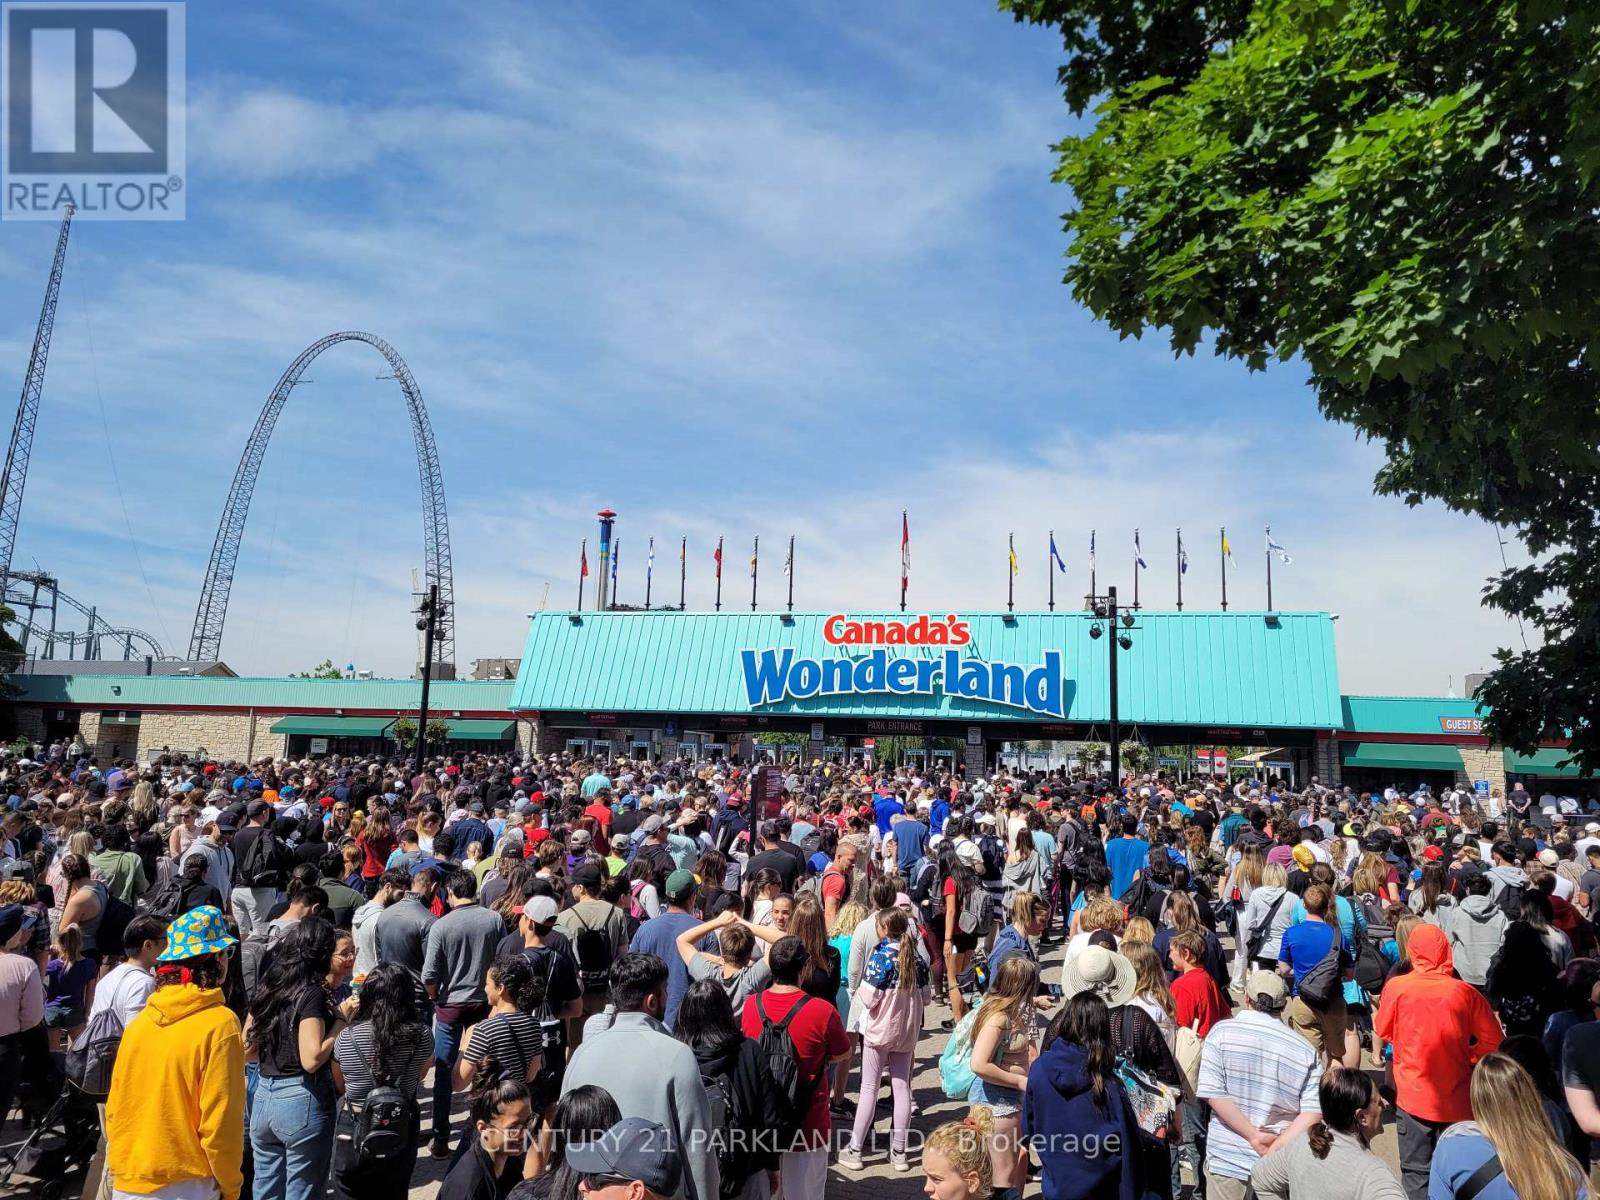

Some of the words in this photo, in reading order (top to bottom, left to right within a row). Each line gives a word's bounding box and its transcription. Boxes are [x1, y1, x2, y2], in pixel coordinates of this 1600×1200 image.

[823, 614, 971, 646] Canada's
[740, 648, 1065, 718] Wonderland
[867, 721, 885, 731] PARK
[888, 721, 923, 732] ENTRANCE
[1446, 719, 1472, 730] GUEST
